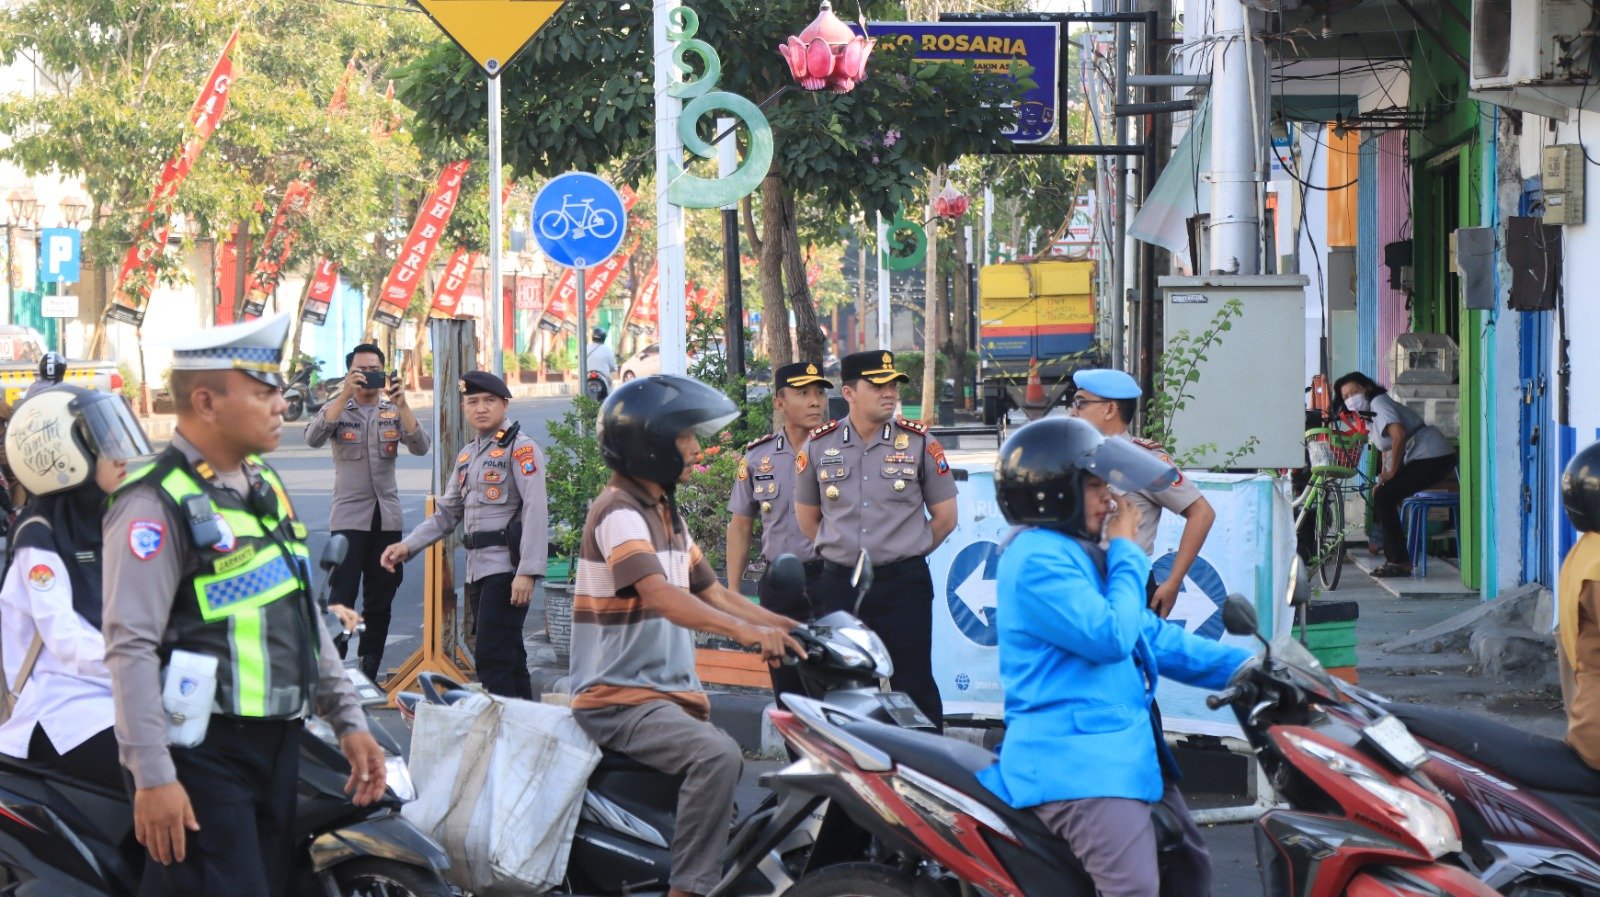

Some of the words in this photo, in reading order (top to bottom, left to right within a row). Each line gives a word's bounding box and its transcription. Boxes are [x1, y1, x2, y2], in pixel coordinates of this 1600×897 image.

[921, 34, 1028, 56] ROSARIA
[430, 161, 464, 220] AJAH
[49, 235, 72, 274] P
[396, 223, 438, 283] BARU
[444, 252, 471, 292] ARU
[482, 460, 506, 469] POLRI
